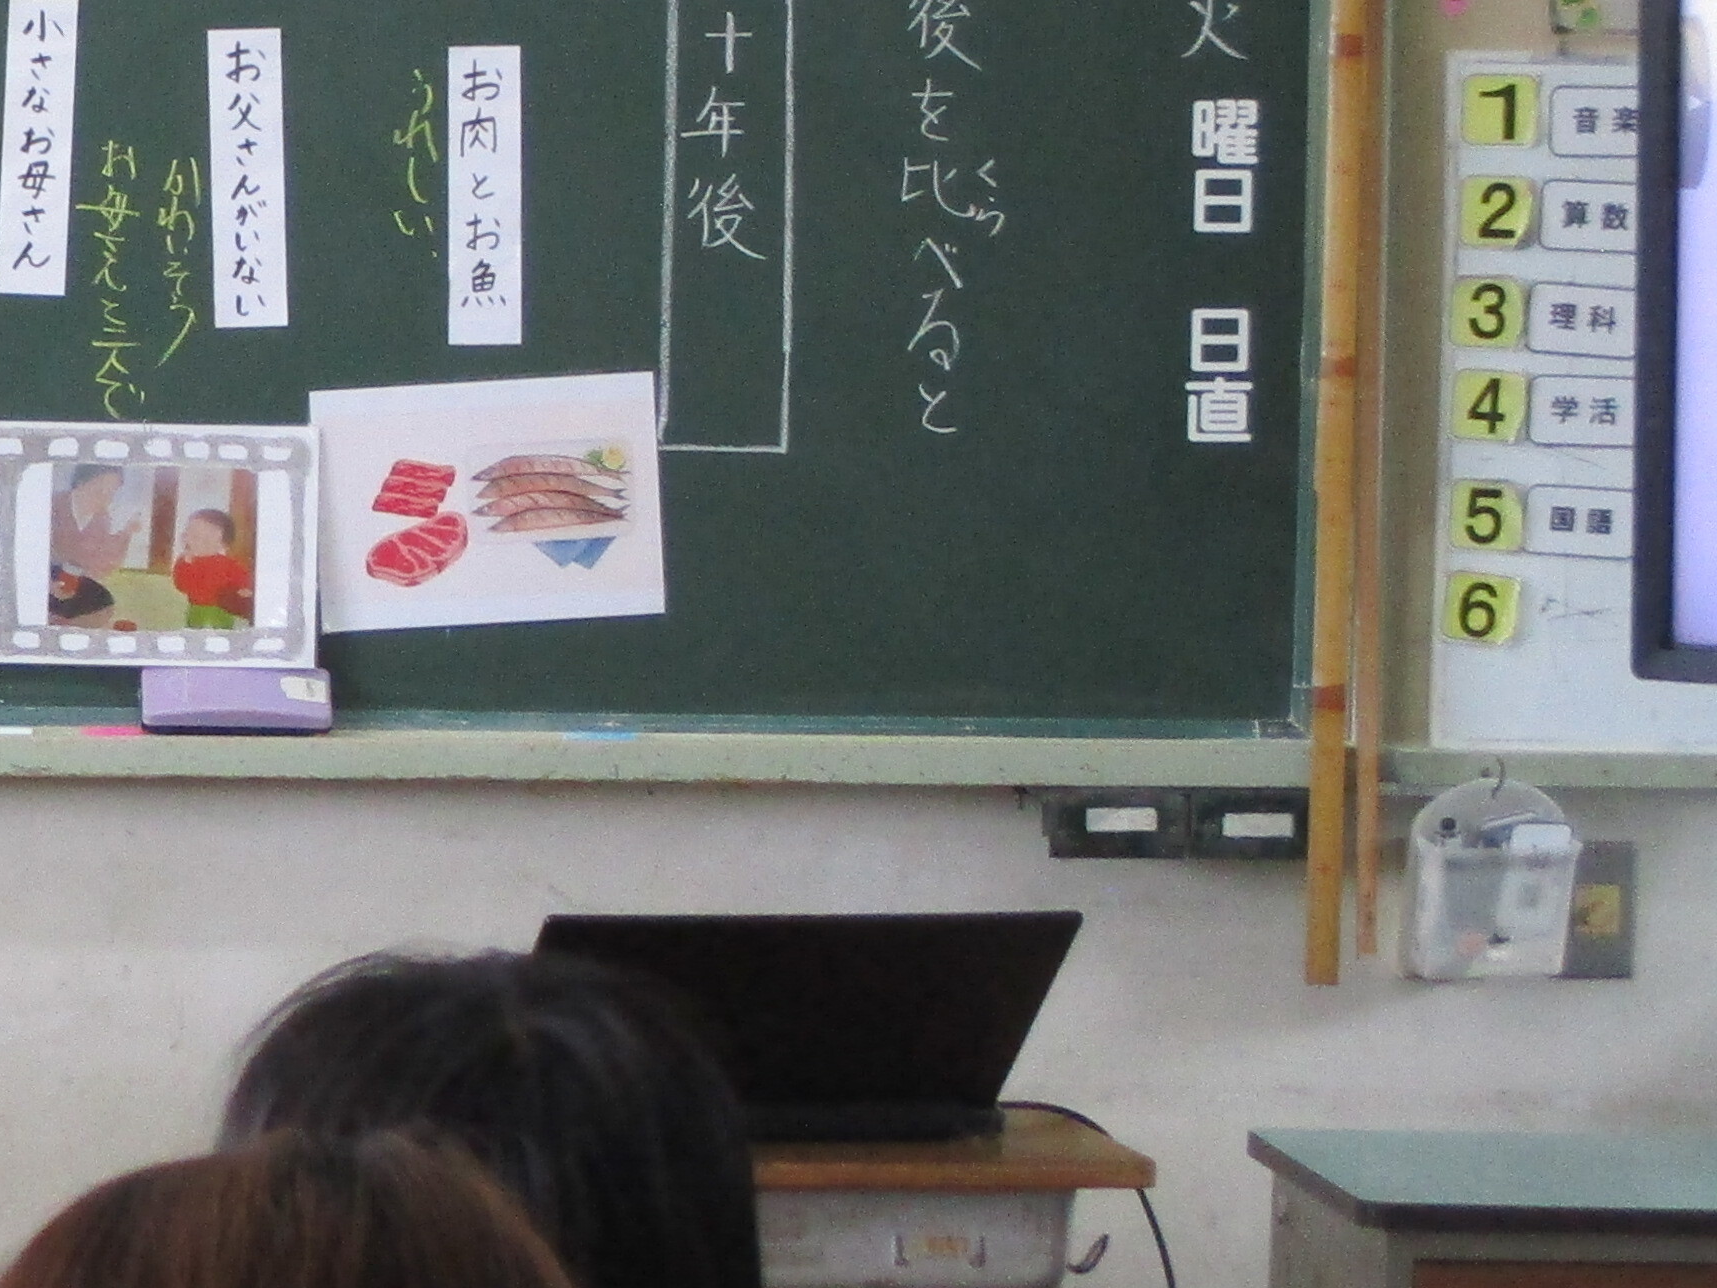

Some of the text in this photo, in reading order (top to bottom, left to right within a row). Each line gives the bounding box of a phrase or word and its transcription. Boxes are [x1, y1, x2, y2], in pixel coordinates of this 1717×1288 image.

[12, 9, 64, 271] 小さなお母さん
[680, 11, 767, 261] 十年後
[1479, 84, 1516, 140] 1
[223, 41, 267, 318] お父さんがいない
[457, 59, 507, 307] お肉とお魚
[1478, 182, 1516, 239] 2
[1468, 283, 1506, 339] 3
[1467, 378, 1505, 434] 4
[1465, 488, 1502, 544] 5
[1459, 583, 1497, 637] 6
